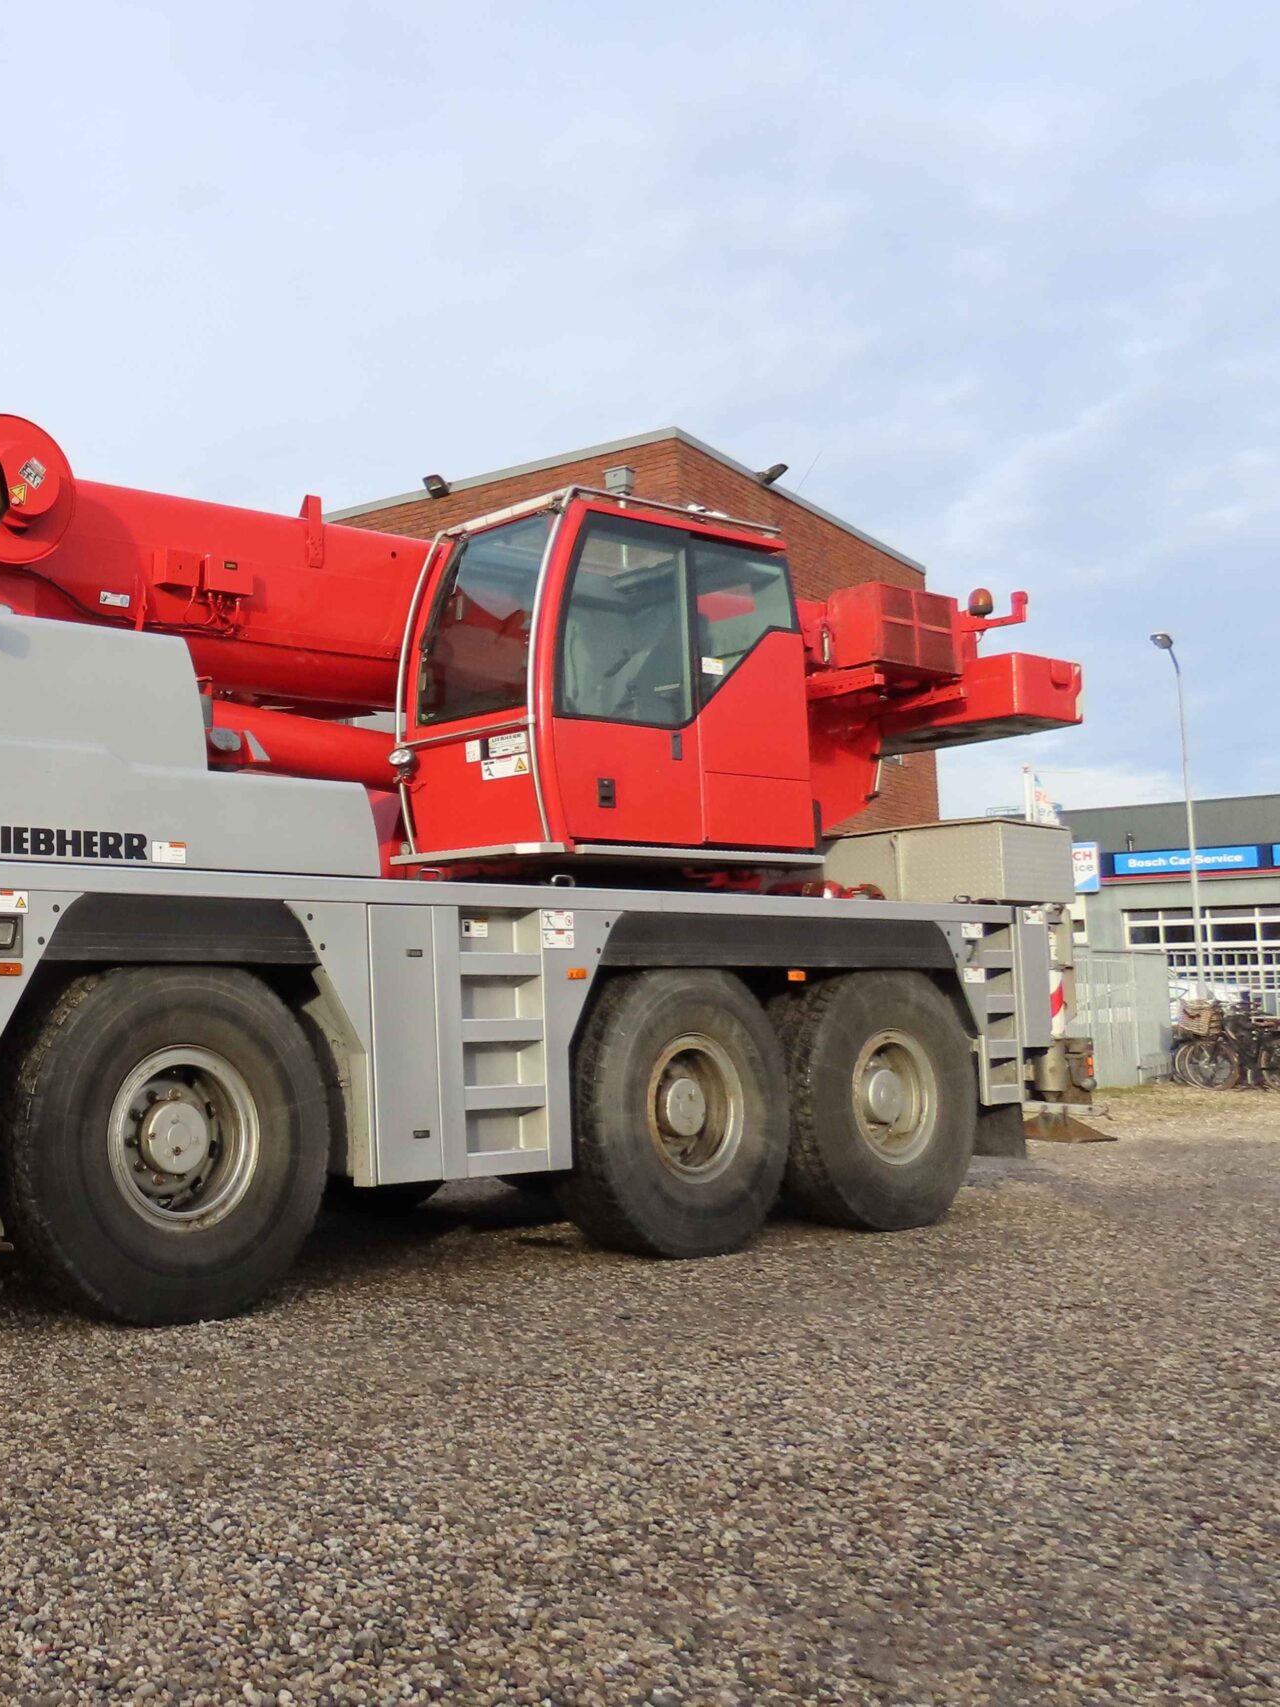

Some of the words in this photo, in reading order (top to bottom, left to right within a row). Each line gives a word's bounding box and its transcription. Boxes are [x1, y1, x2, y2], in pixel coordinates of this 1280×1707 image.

[1128, 857, 1167, 868] Bosch
[1169, 856, 1192, 866] Car
[1194, 853, 1244, 864] Service
